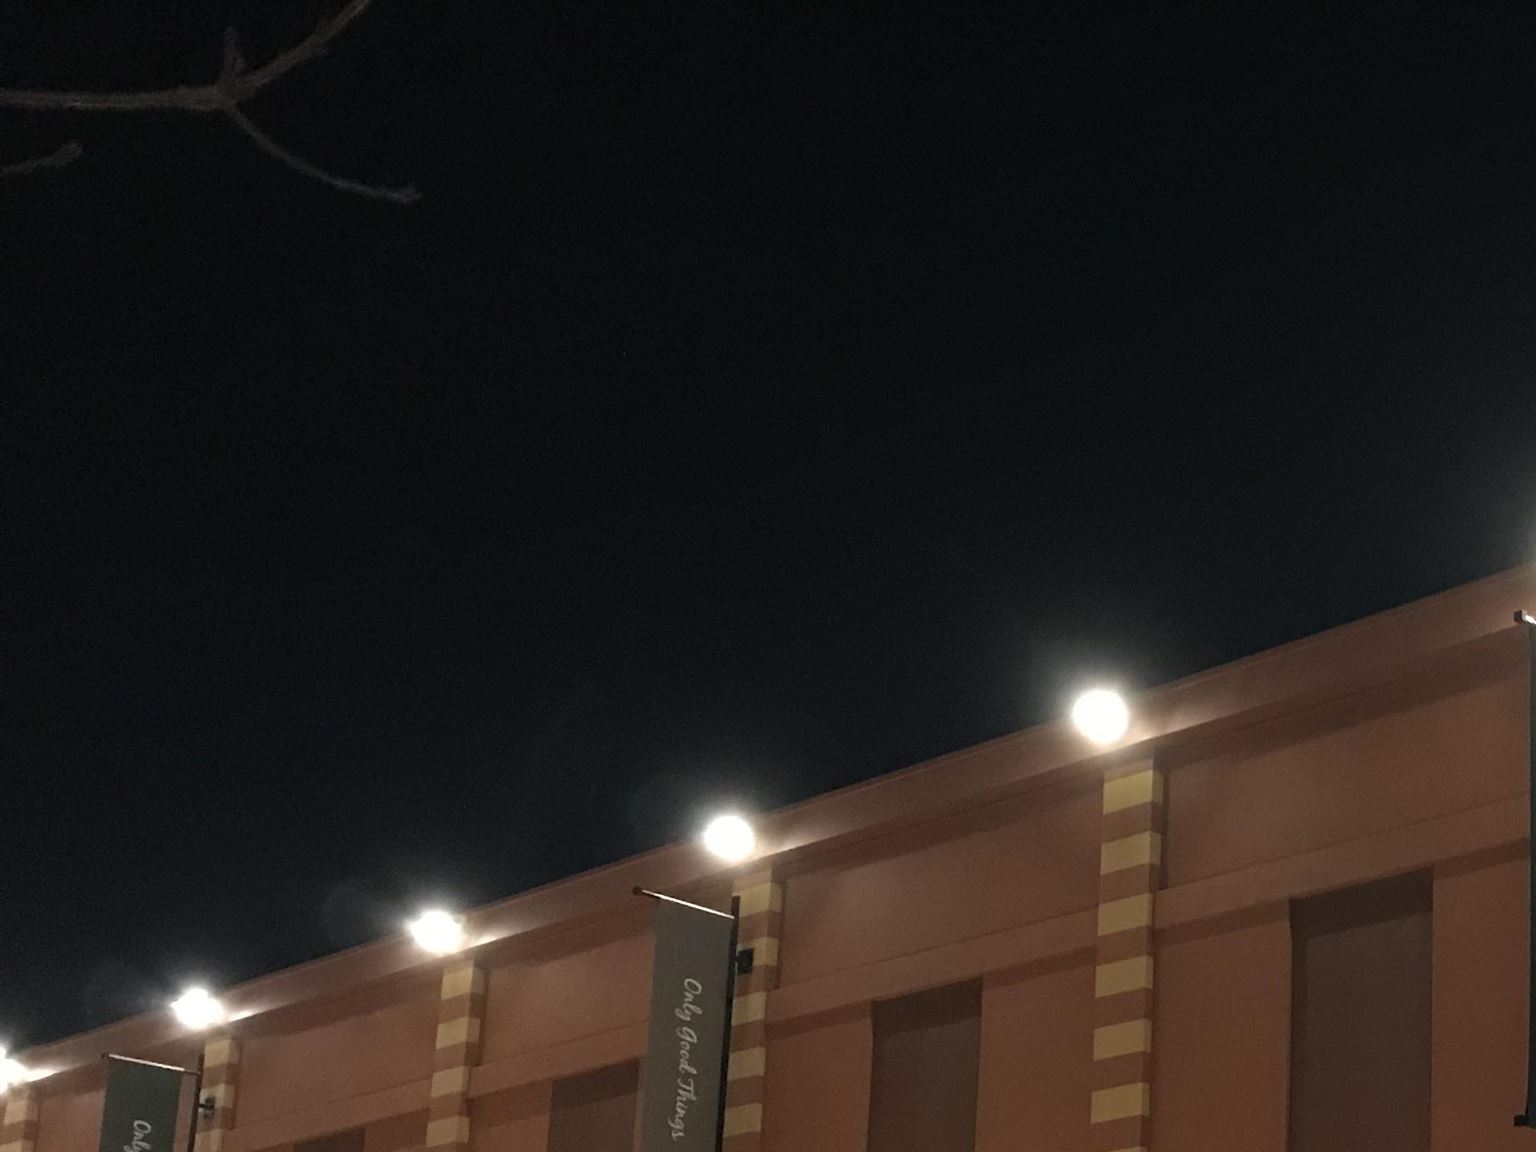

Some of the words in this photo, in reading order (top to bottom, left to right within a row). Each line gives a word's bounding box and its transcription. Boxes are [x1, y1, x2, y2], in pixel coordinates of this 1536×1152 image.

[675, 978, 703, 1022] Only
[676, 1026, 698, 1075] Good
[668, 1077, 697, 1142] Things
